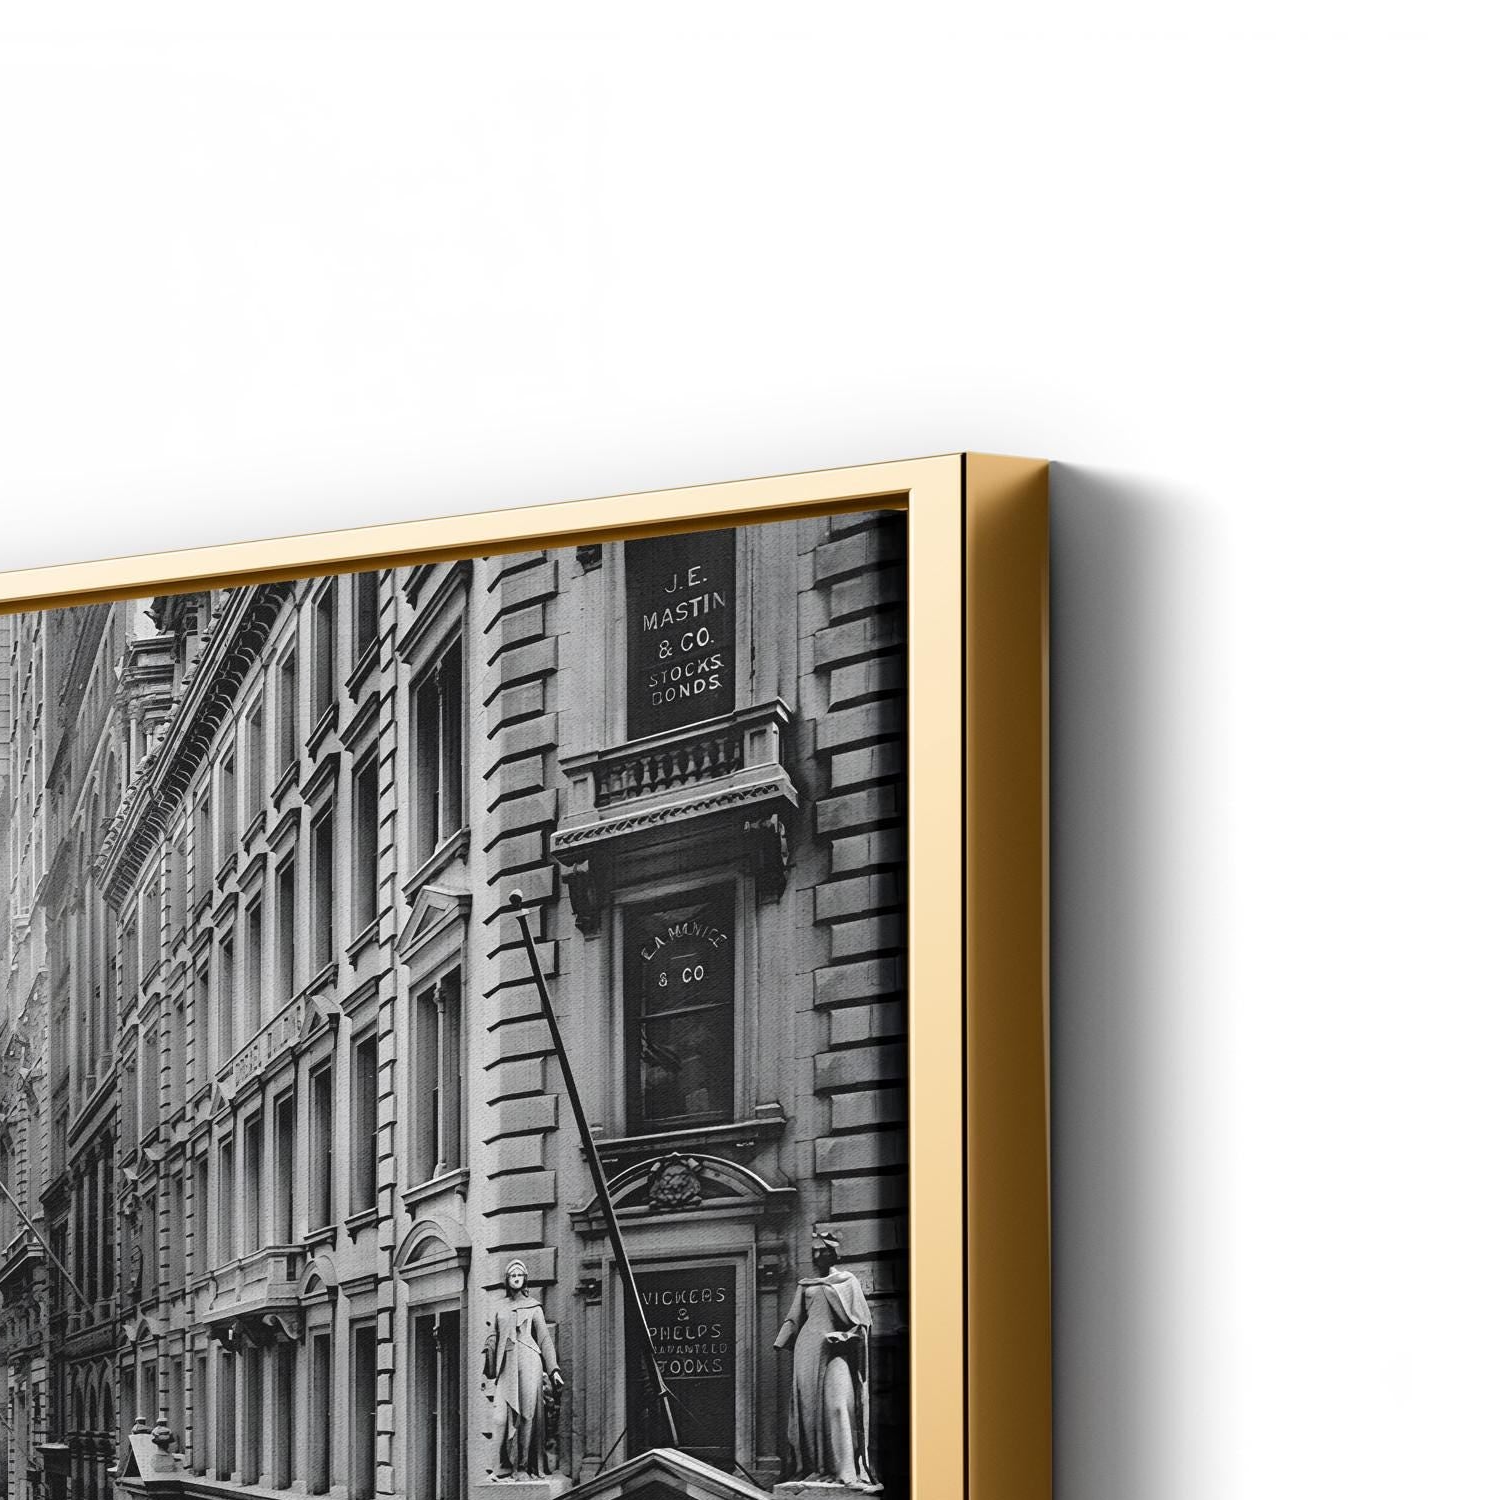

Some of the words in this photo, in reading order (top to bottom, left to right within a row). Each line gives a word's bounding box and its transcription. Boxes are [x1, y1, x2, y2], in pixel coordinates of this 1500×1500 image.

[665, 566, 708, 593] J.E.
[643, 591, 727, 632] MASTIN
[659, 640, 673, 659] &
[680, 627, 715, 652] CO.
[649, 654, 725, 687] STOCKS
